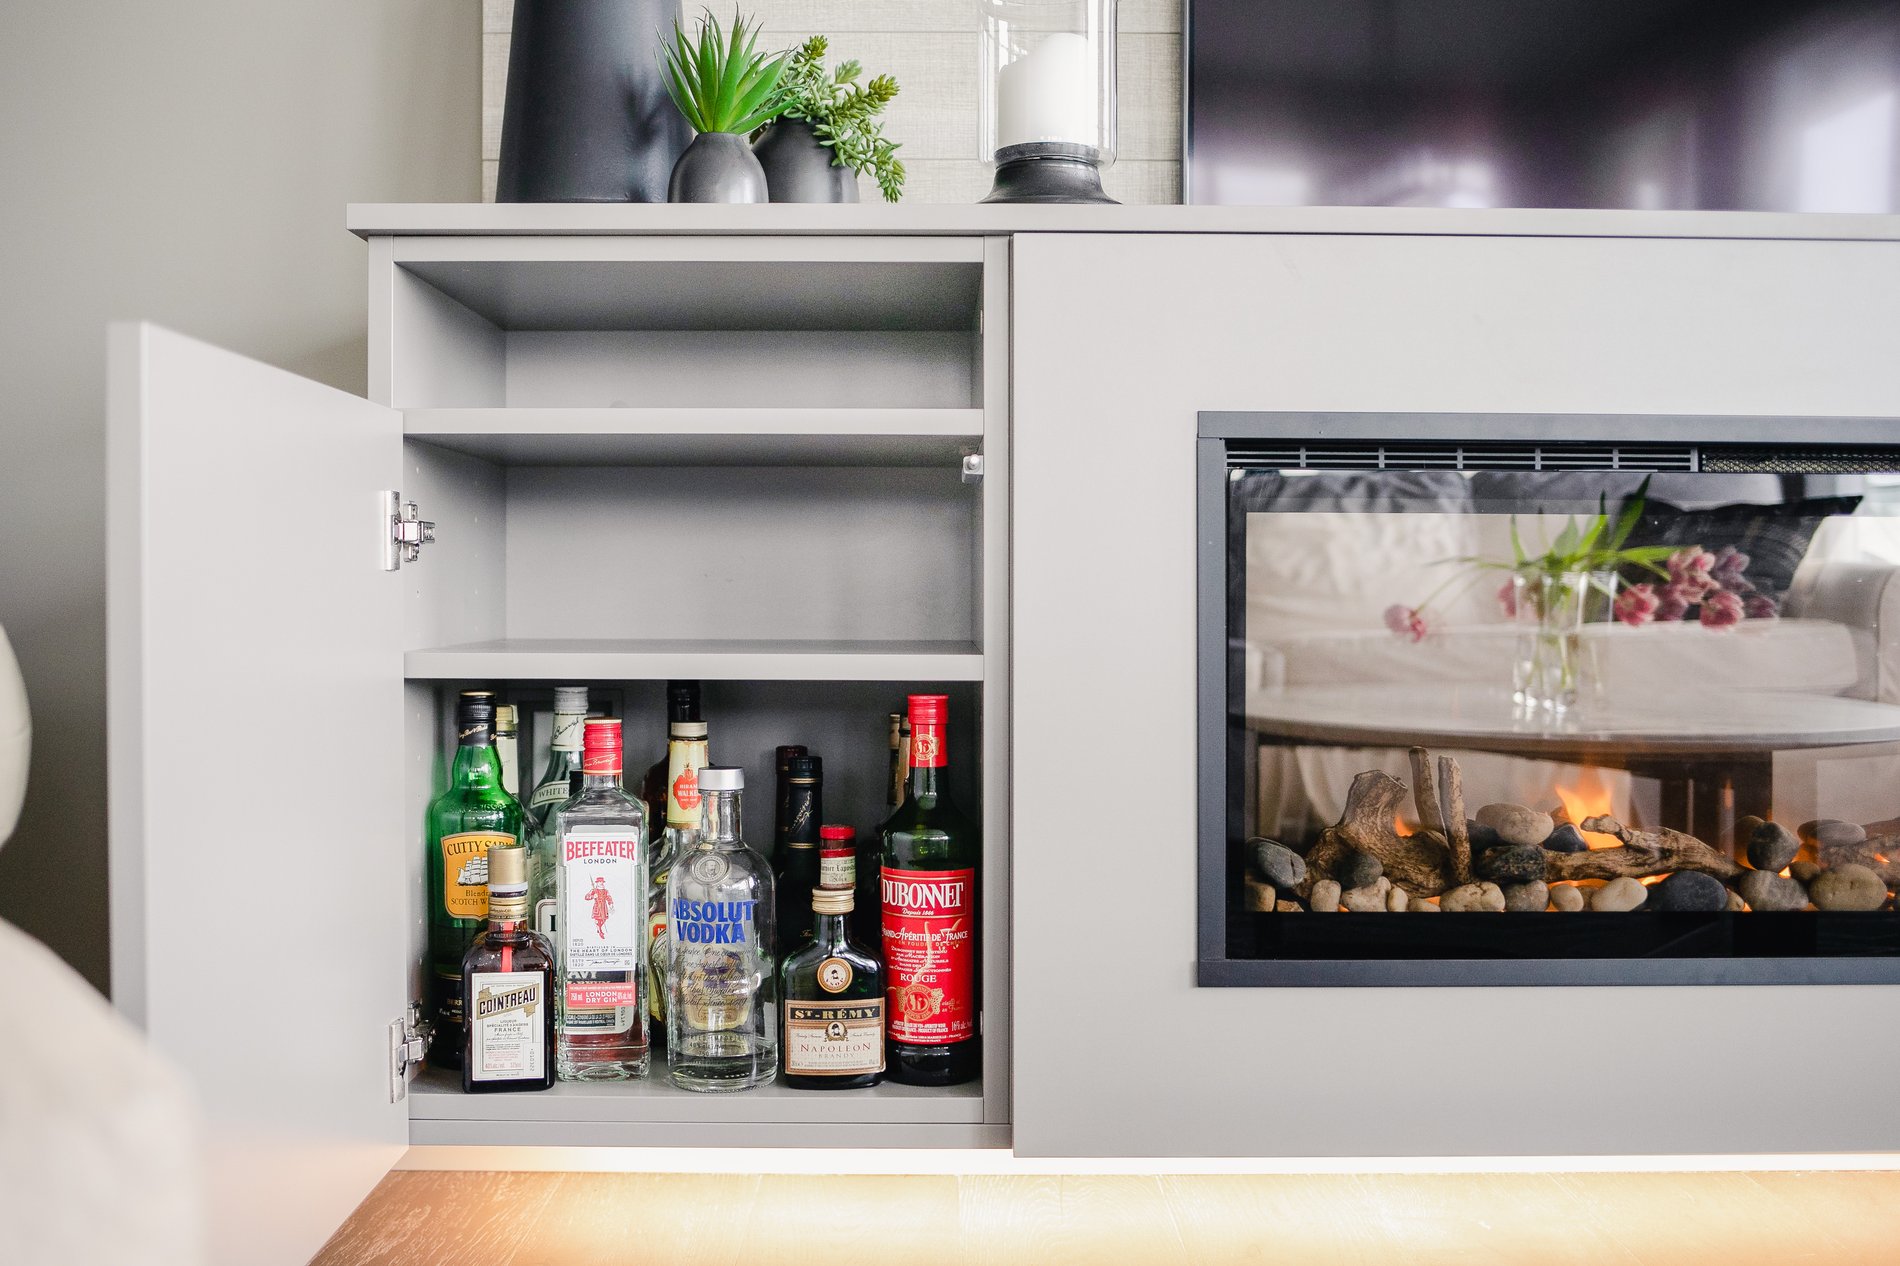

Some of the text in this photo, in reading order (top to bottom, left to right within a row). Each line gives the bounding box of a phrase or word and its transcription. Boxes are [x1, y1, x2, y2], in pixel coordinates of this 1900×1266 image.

[447, 841, 472, 856] CUTTY
[567, 841, 635, 861] BEEFEATER
[882, 879, 964, 908] DUBONNET
[451, 898, 478, 906] SCOTCH
[673, 897, 755, 922] ABSOLUT
[902, 908, 921, 916] Depuis
[677, 920, 746, 944] VODKA
[932, 933, 942, 942] DE
[940, 928, 968, 944] FRANCE
[900, 973, 937, 983] ROUGE
[479, 987, 537, 1015] COINTREAU
[800, 1042, 871, 1053] NAPOLEON
